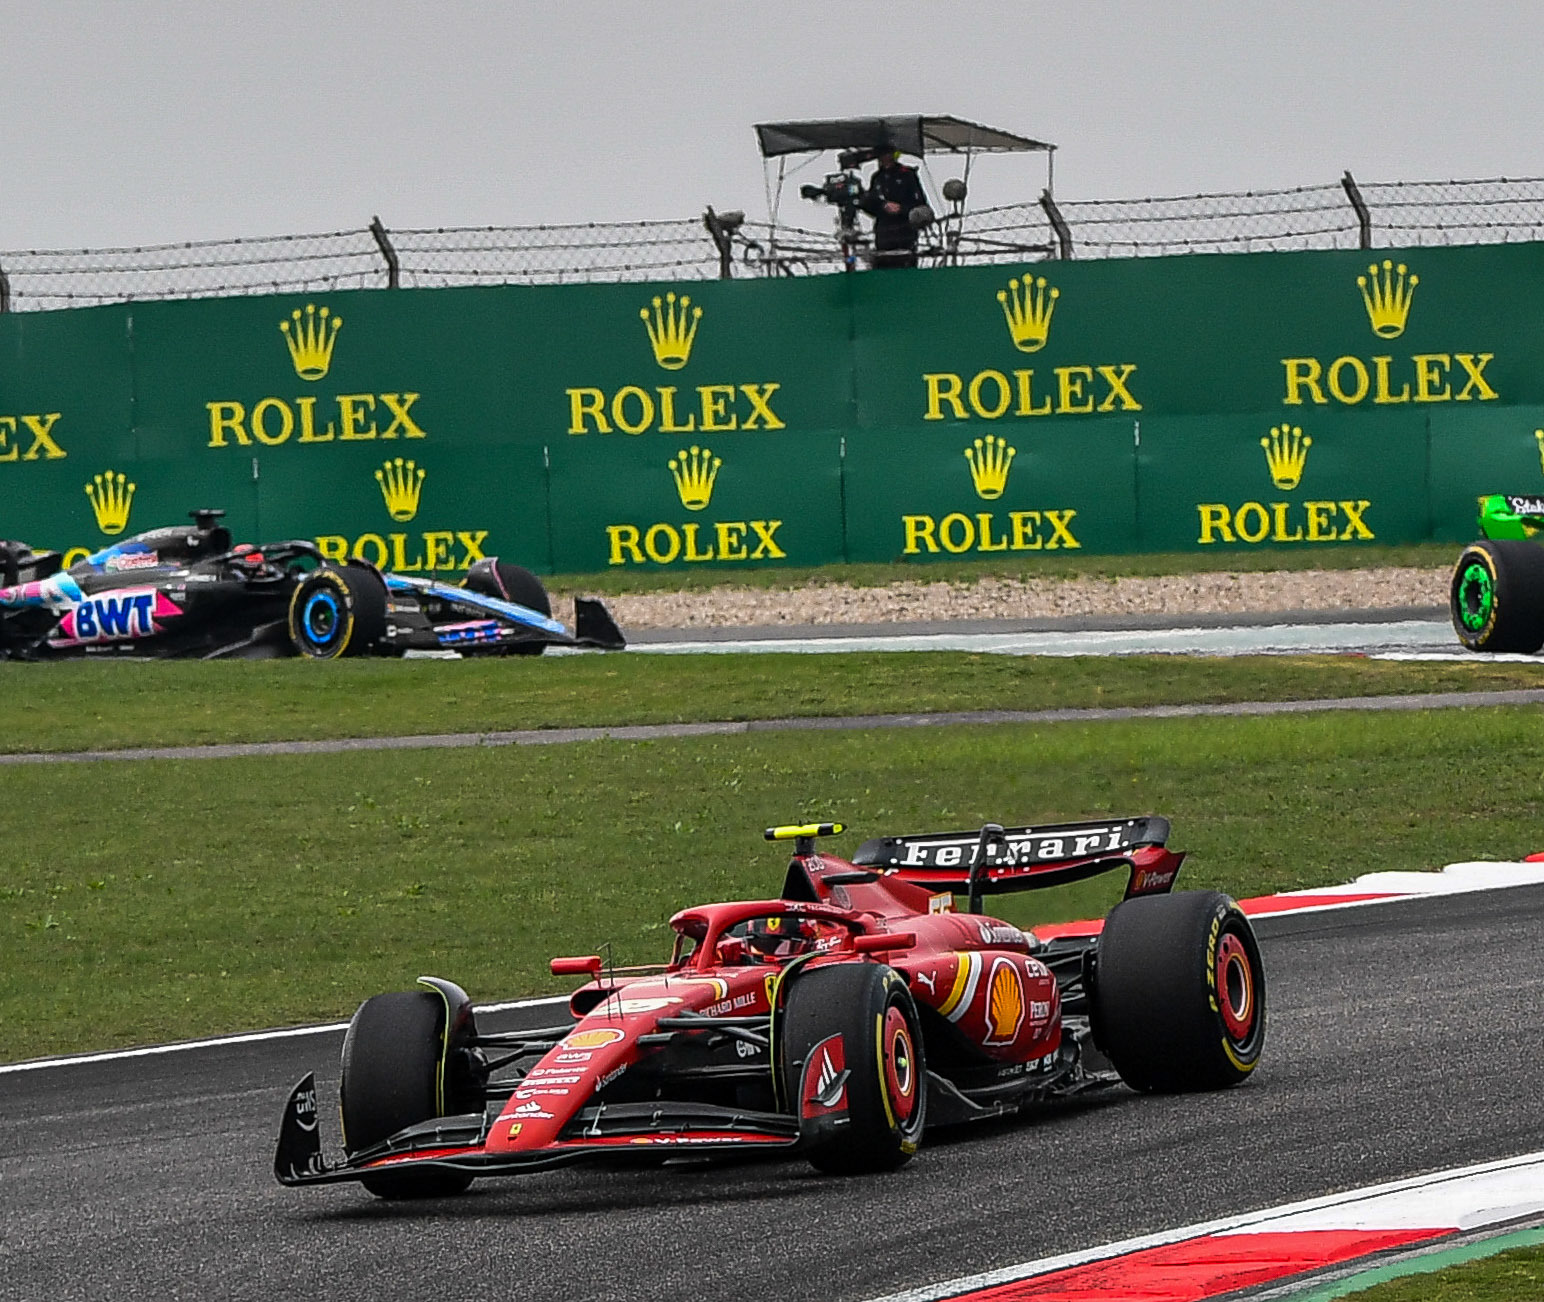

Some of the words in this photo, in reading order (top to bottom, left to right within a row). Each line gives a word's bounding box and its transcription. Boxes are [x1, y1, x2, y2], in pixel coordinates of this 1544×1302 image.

[922, 364, 1142, 420] ROLEX
[1286, 353, 1498, 405] ROLEX
[207, 392, 426, 447] ROLEX
[566, 382, 785, 435] ROLEX
[606, 520, 786, 564] ROLEX
[902, 509, 1081, 554] ROLEX
[1197, 499, 1375, 544] ROLEX
[76, 595, 154, 638] BWT
[900, 826, 1124, 867] Ferrari
[1206, 917, 1220, 989] ZERO
[733, 992, 757, 1009] MILLE
